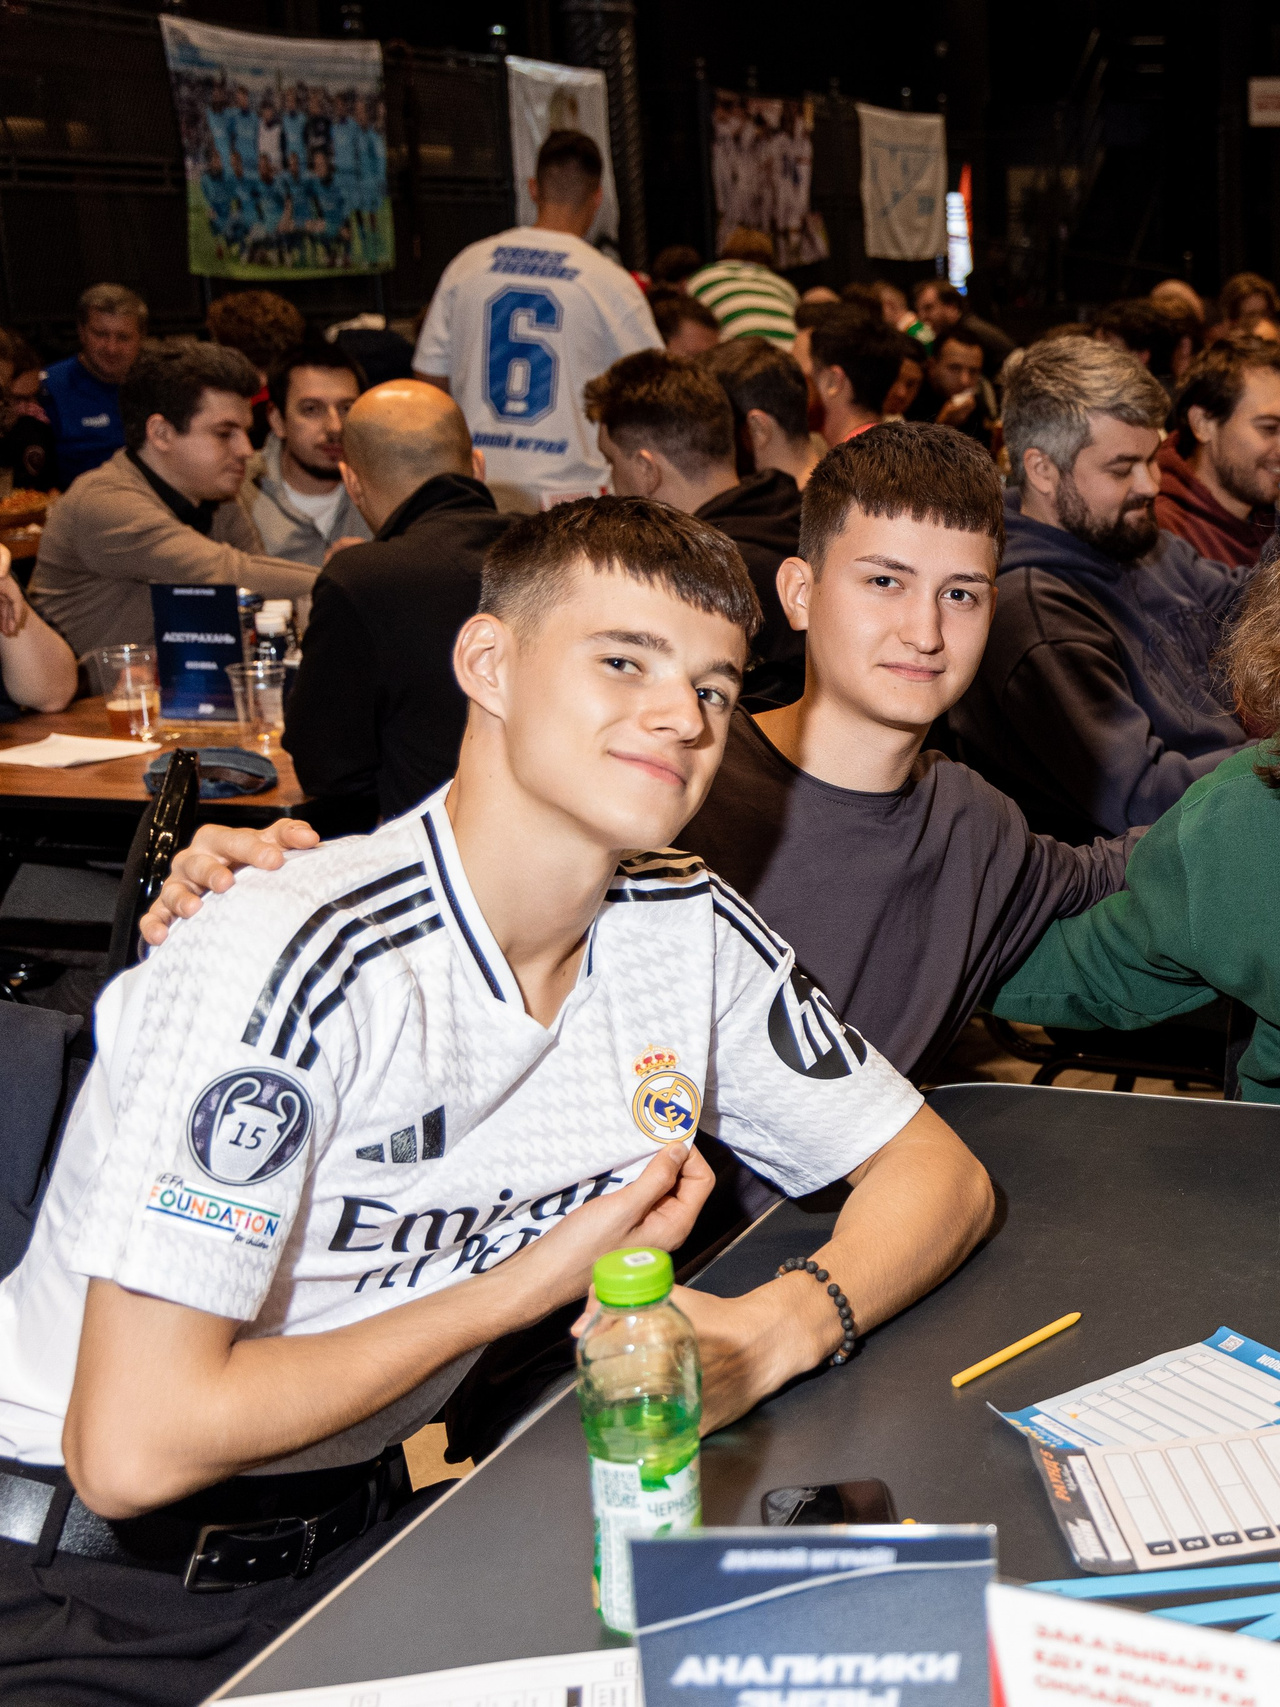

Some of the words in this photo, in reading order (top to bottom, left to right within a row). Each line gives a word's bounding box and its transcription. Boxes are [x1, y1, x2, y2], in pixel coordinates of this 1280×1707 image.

[481, 283, 563, 426] 6
[229, 1121, 268, 1150] 15
[150, 1186, 279, 1237] FOUNDATION
[1186, 1539, 1203, 1549] 2
[1218, 1534, 1236, 1545] 3
[1251, 1529, 1268, 1539] 4
[1153, 1544, 1170, 1553] 1
[670, 1653, 963, 1687] АНАЛИТИКИ
